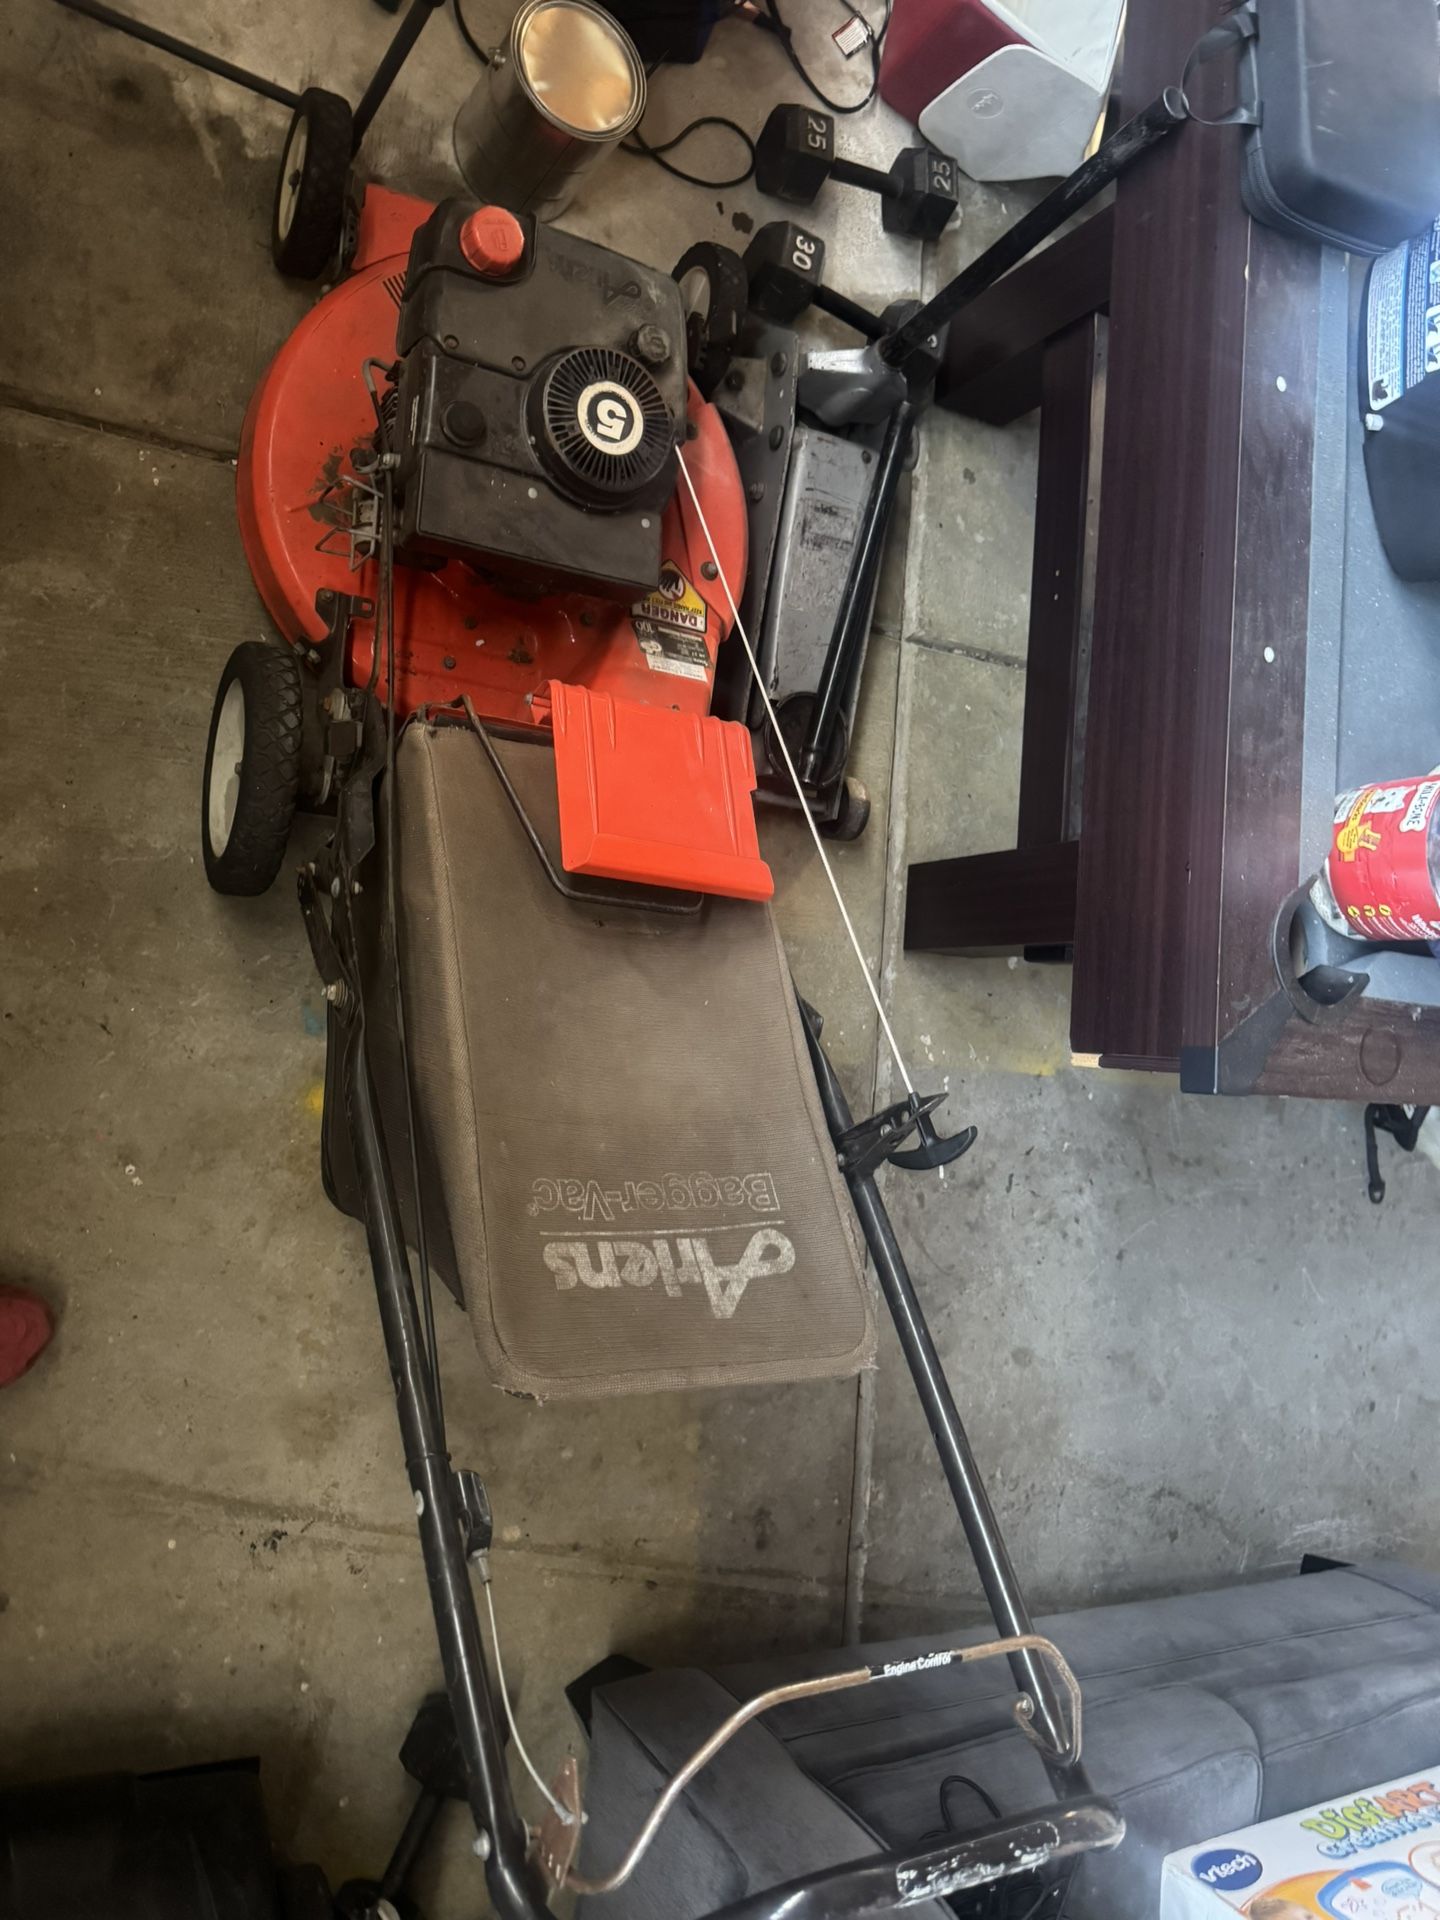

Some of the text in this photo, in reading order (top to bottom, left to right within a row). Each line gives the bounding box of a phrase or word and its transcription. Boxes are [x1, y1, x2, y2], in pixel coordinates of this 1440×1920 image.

[807, 114, 827, 150] 25
[933, 160, 951, 191] 25
[792, 235, 815, 271] 30
[596, 399, 627, 440] 5
[641, 603, 698, 627] DANGER
[531, 1171, 781, 1221] Bagger-Vac
[543, 1228, 796, 1319] Ariens
[883, 1652, 952, 1677] Engine Control
